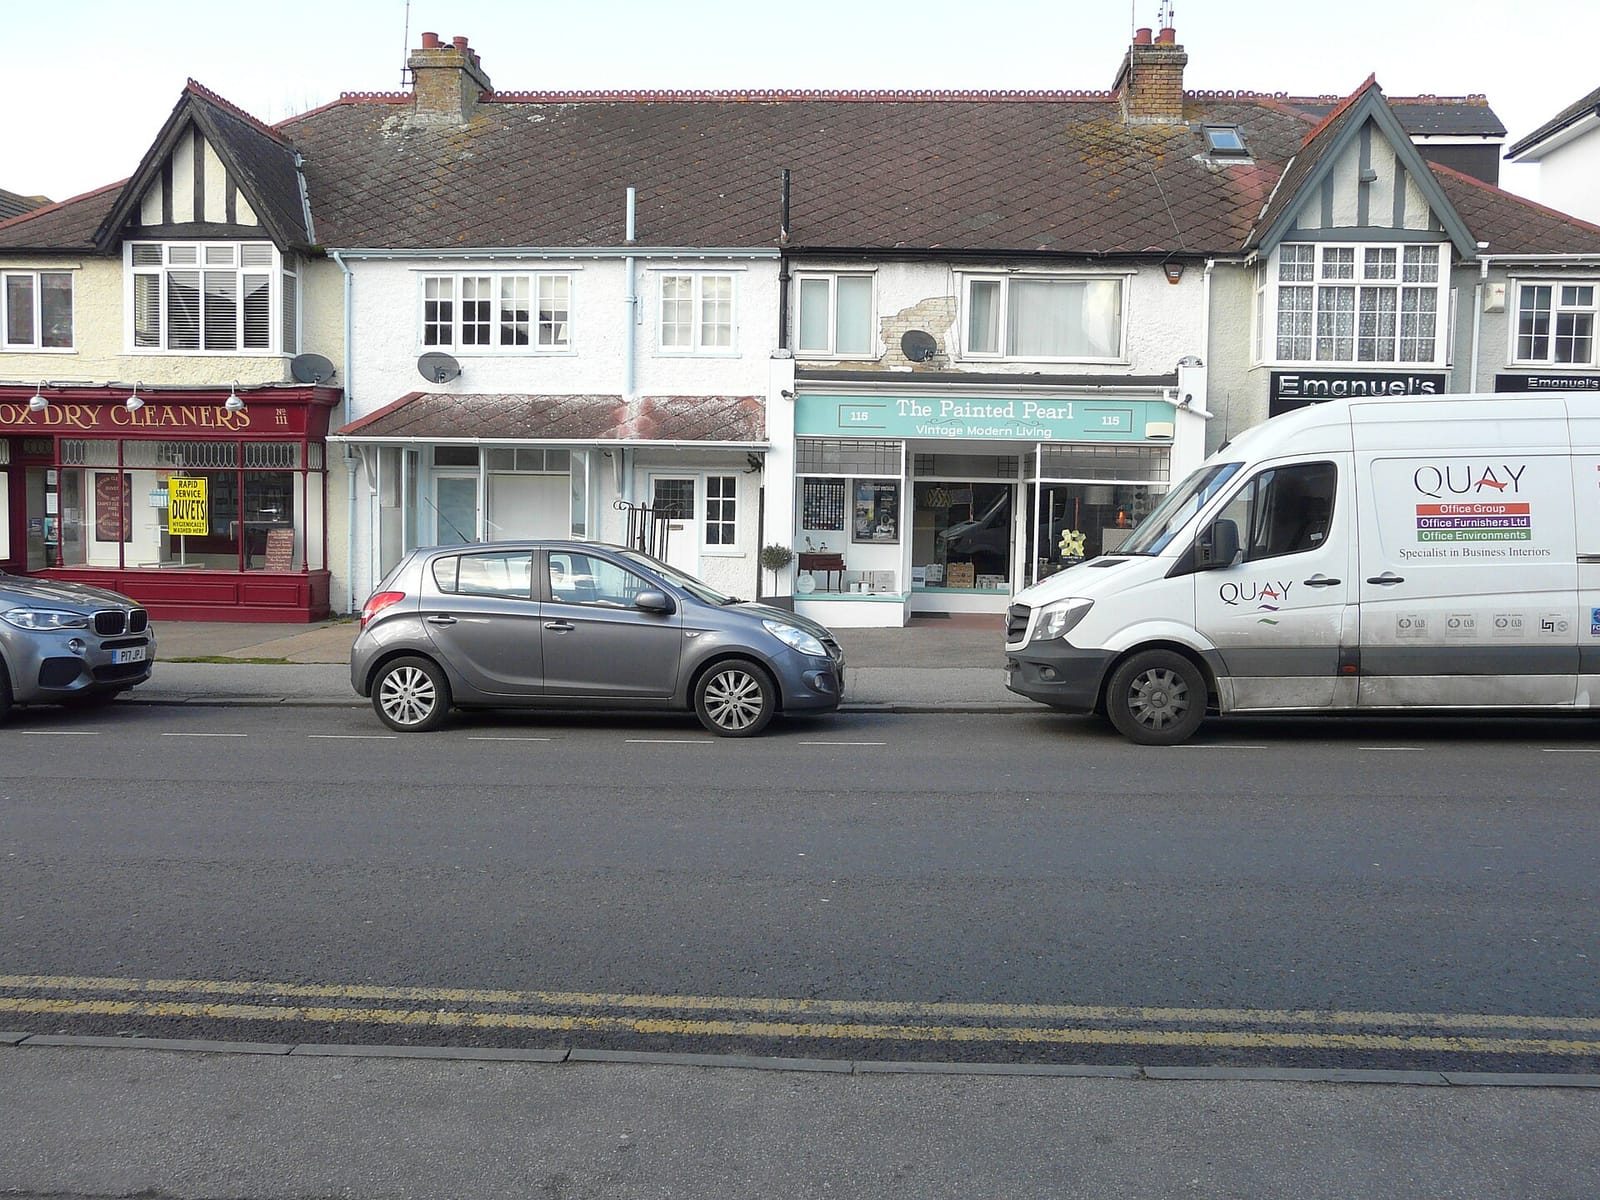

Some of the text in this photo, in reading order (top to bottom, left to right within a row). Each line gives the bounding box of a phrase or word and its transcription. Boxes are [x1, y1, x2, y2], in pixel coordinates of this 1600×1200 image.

[1279, 375, 1436, 396] Emanuel's
[1527, 377, 1599, 388] Emanuel's
[896, 399, 1074, 420] The Painted Pearl
[43, 404, 103, 429] DRY
[110, 404, 251, 431] CLEANERS
[850, 411, 869, 422] 115
[1101, 415, 1120, 426] 115
[915, 425, 1053, 439] Vintage Modern Living
[178, 480, 198, 489] RAPID
[1413, 464, 1527, 499] QUAY
[175, 489, 202, 498] SERVICE
[172, 499, 205, 521] DUVETS
[1439, 503, 1506, 515] Office Group
[1420, 515, 1527, 528] Office Furnishers Ltd
[1422, 530, 1527, 541] Office Environments
[1399, 546, 1551, 560] Specialist in Business Interiors
[1219, 580, 1293, 606] QUAY
